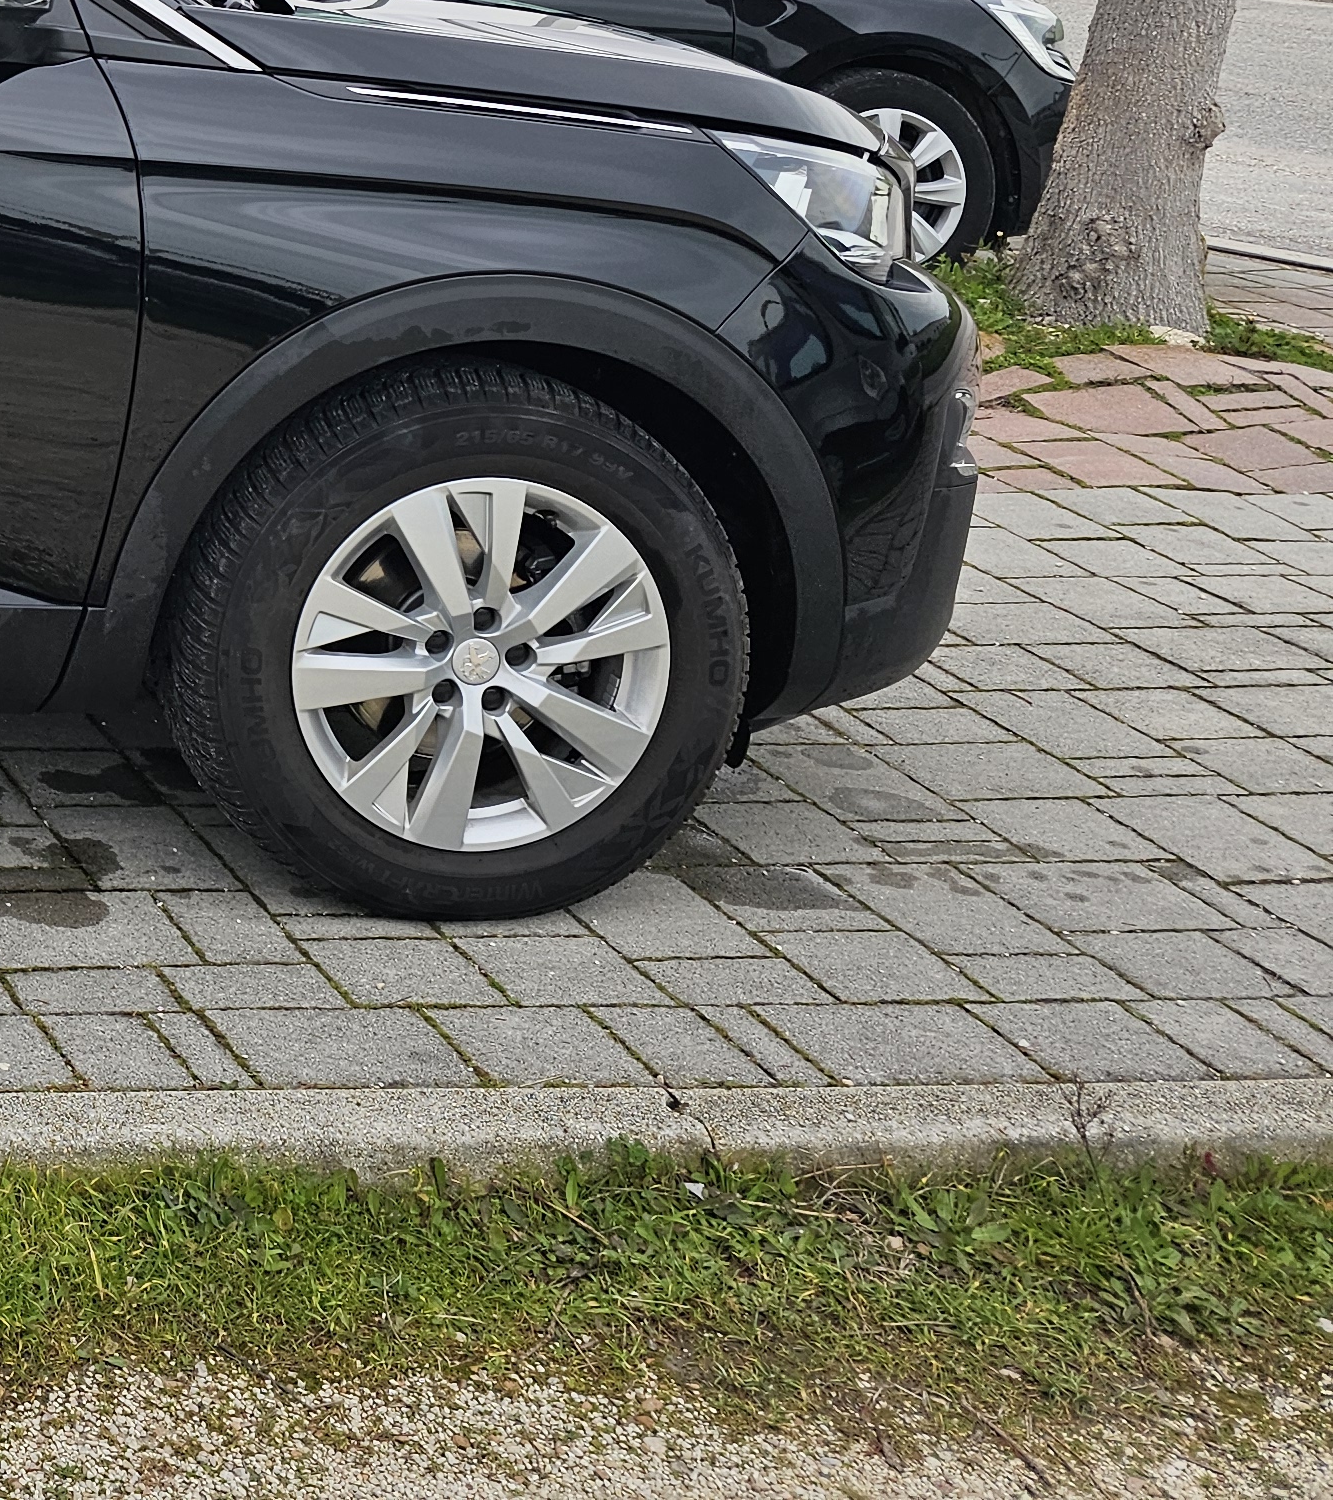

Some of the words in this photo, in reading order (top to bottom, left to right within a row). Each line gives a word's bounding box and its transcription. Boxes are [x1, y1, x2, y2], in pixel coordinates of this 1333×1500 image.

[454, 428, 534, 447] 215/65
[683, 543, 730, 687] KUMHO
[240, 647, 280, 767] UMHO
